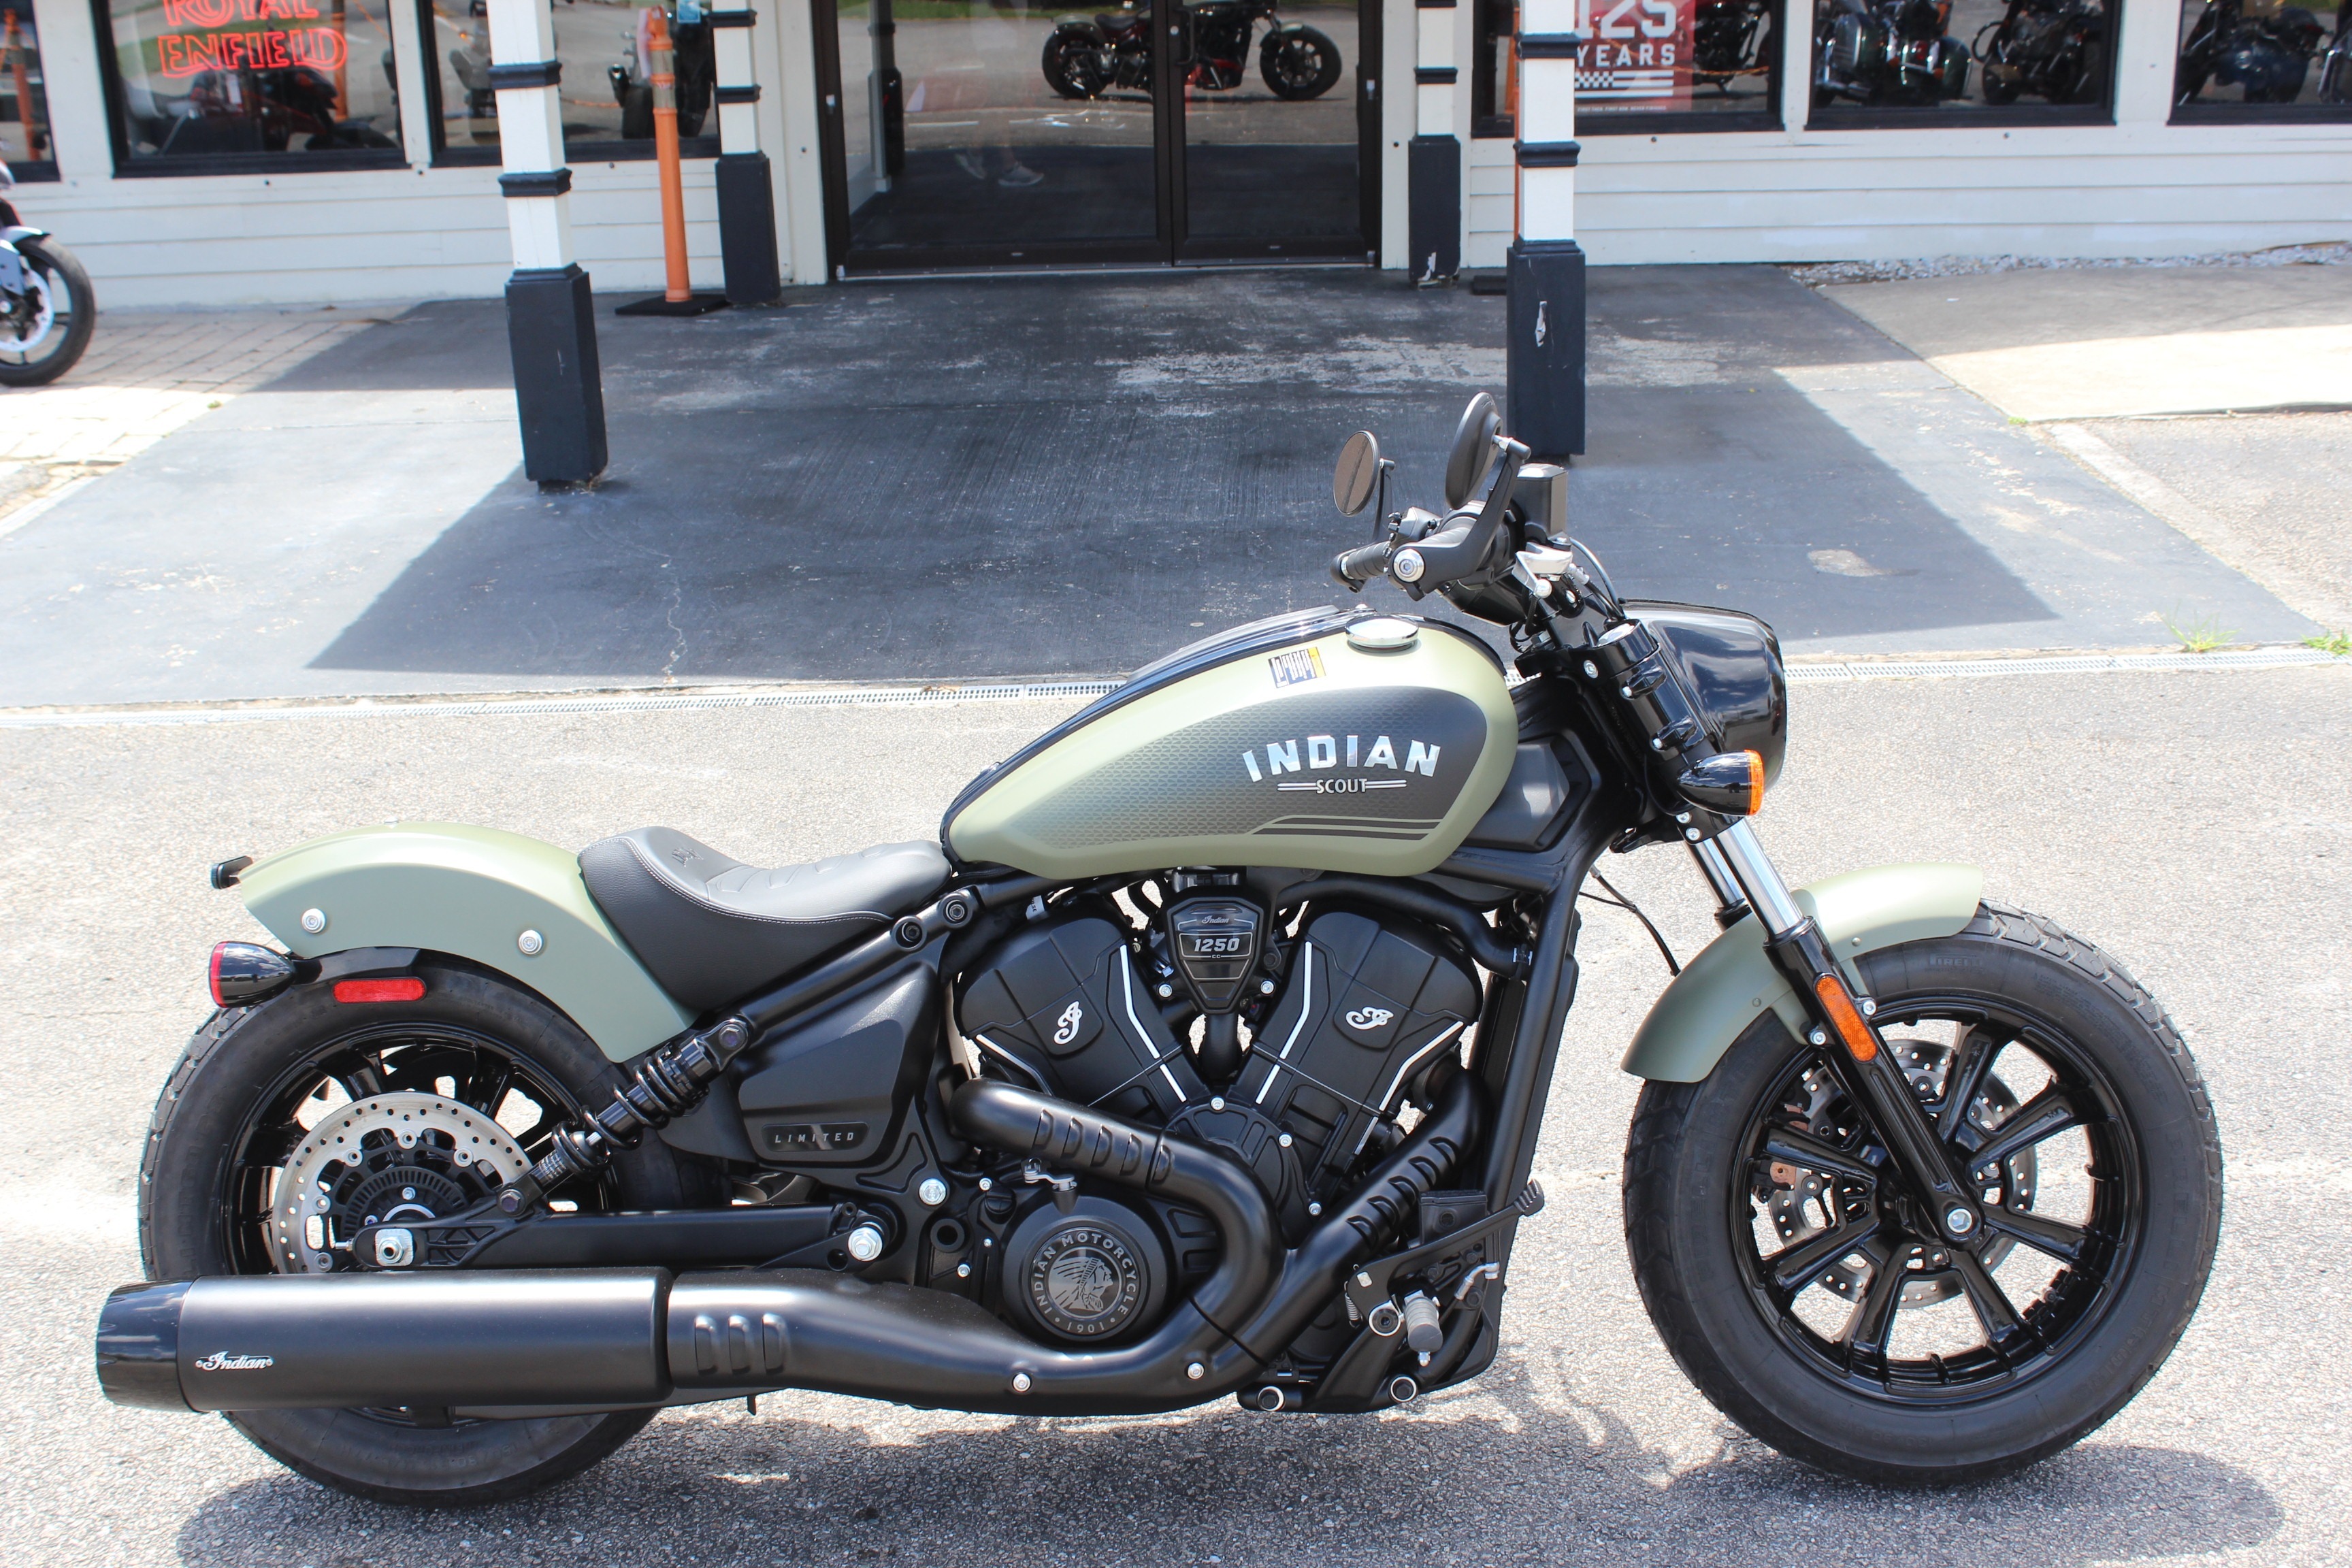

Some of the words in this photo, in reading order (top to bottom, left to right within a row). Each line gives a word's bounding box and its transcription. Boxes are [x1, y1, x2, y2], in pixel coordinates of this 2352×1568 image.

[163, 0, 320, 28] ROYAL
[157, 27, 348, 78] ENFIELD
[1577, 43, 1675, 67] YEARS
[1242, 735, 1441, 783] INDIAN
[1316, 778, 1368, 794] SCOUT
[1201, 915, 1230, 924] Indian
[1194, 937, 1240, 952] 1250
[774, 1132, 854, 1143] LIMITED
[1034, 1246, 1057, 1314] INDIAN
[1061, 1232, 1137, 1316] MOTORCYCLE
[1067, 1322, 1105, 1333] 1901
[201, 1350, 267, 1371] Indian
